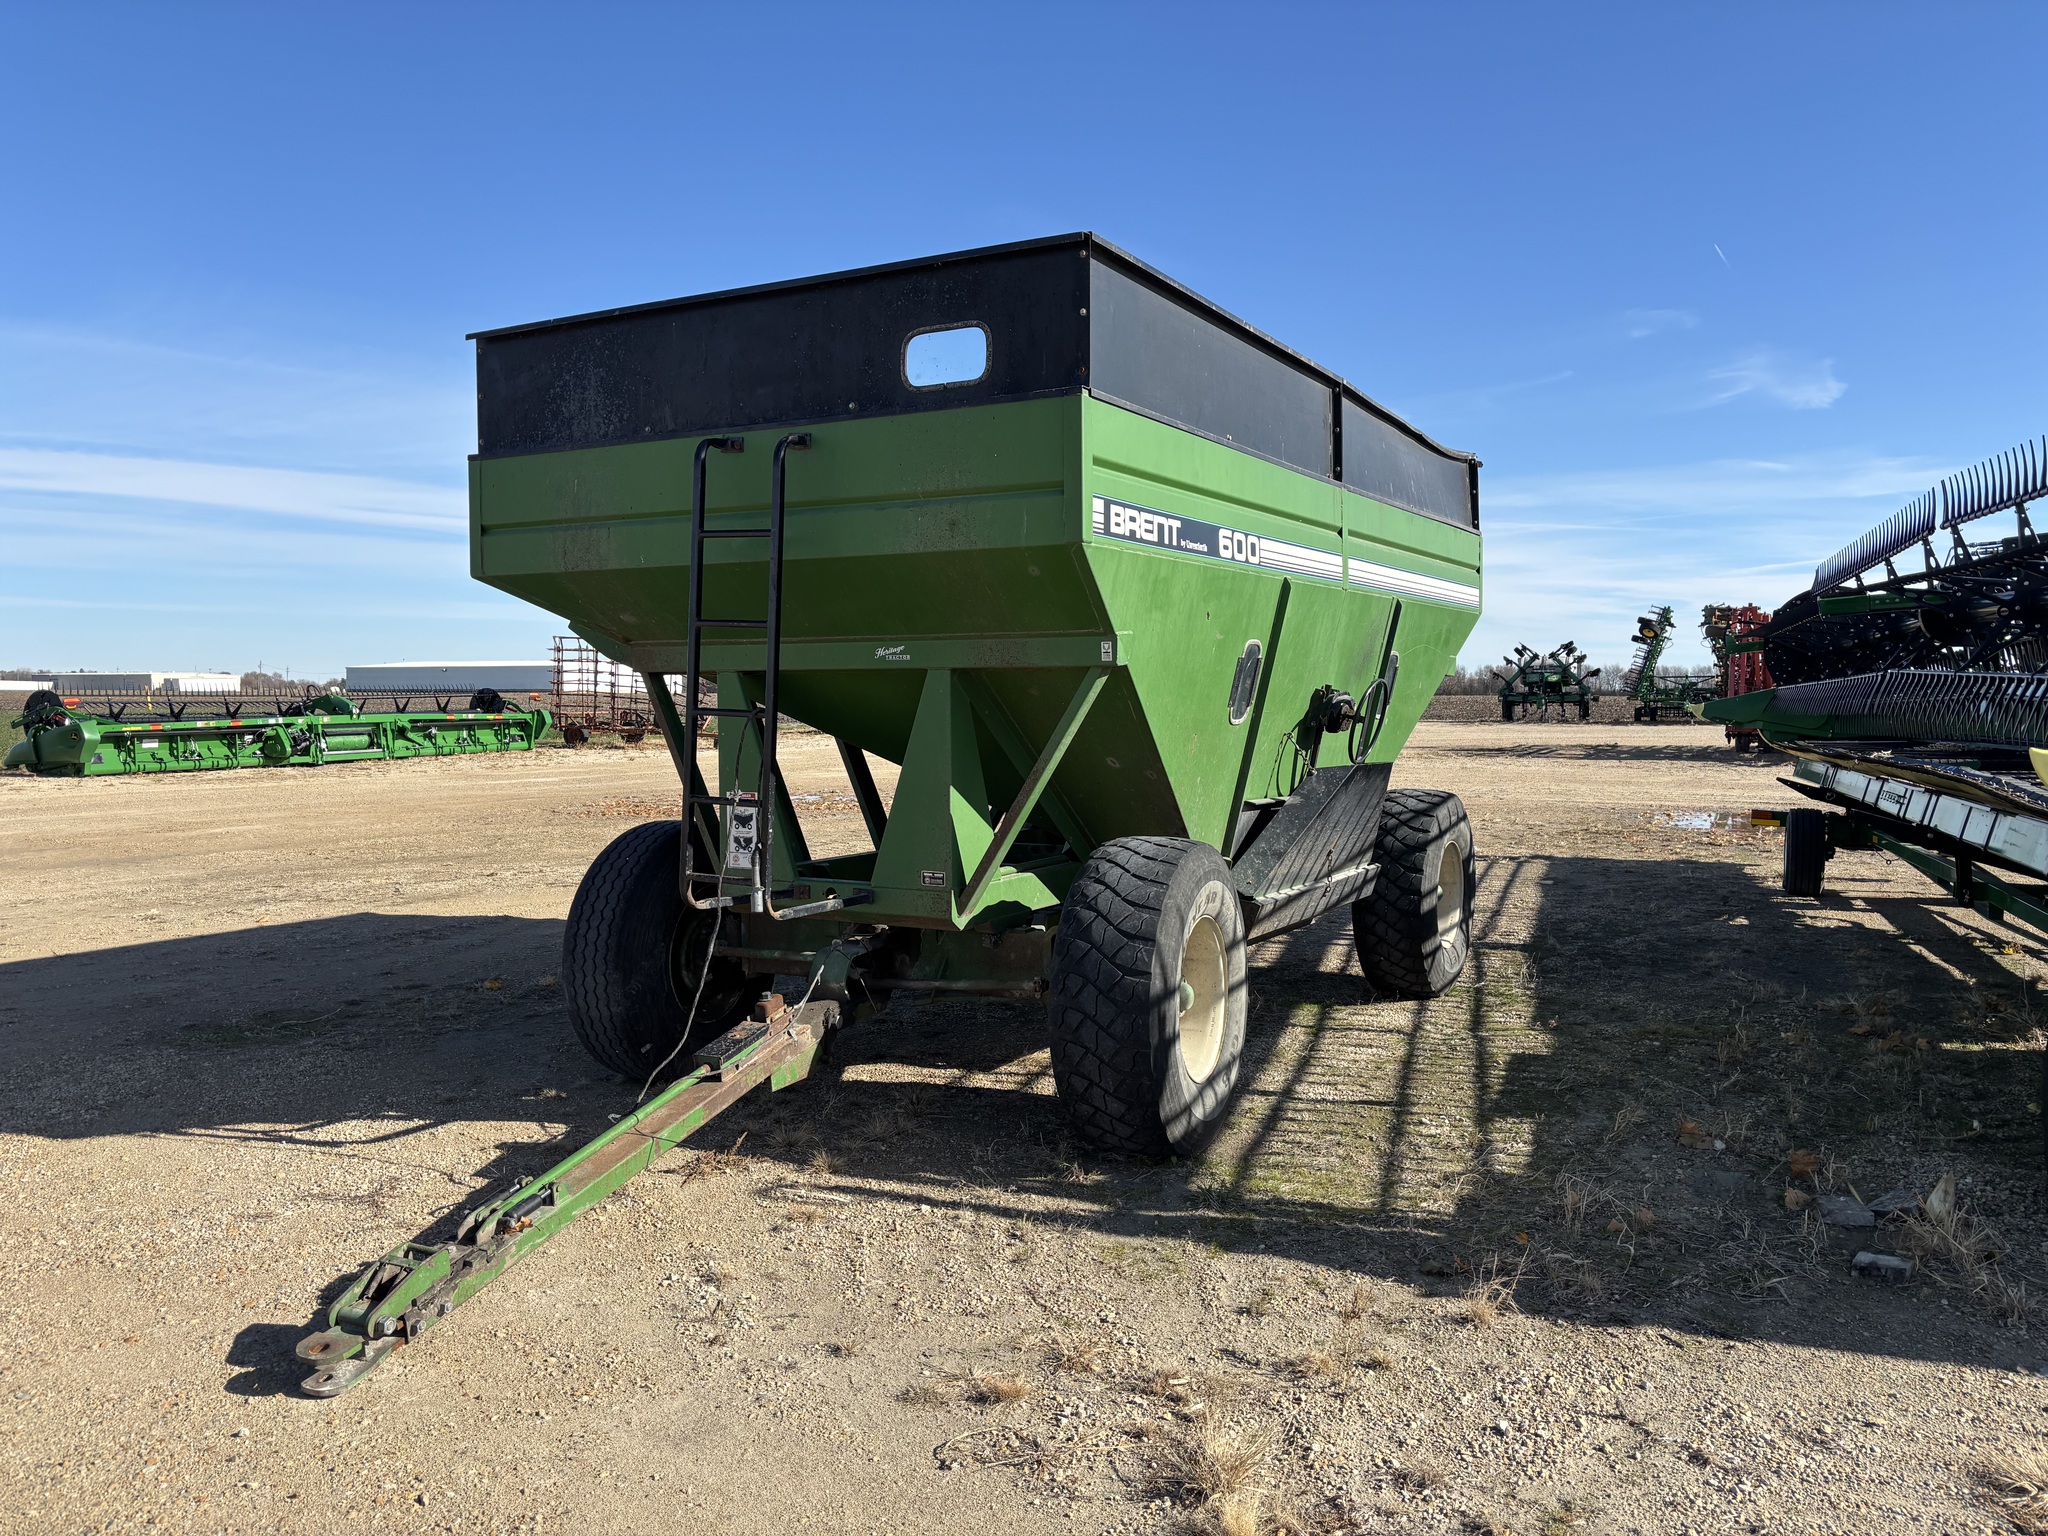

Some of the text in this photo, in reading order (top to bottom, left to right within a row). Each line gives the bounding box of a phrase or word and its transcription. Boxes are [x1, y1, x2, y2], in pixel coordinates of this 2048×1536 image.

[1110, 504, 1181, 545] BRENT
[1219, 528, 1260, 565] 600
[874, 645, 905, 659] Heritage
